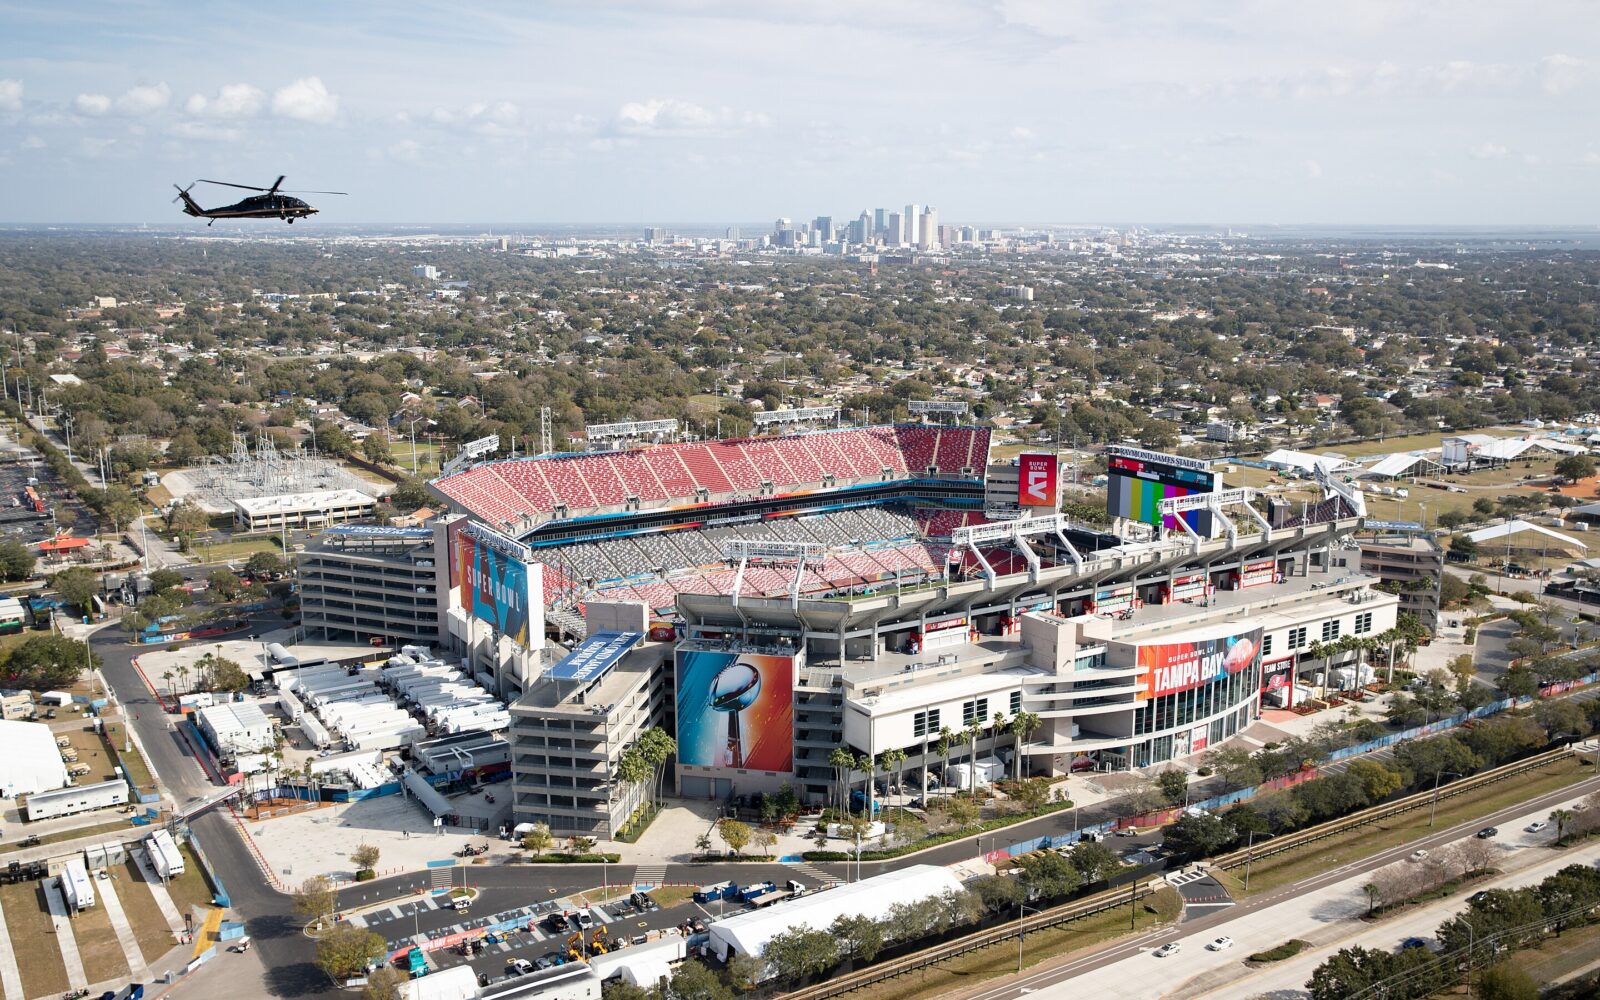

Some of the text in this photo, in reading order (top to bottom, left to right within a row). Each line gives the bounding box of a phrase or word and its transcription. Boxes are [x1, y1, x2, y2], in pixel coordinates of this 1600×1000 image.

[1120, 448, 1205, 469] RAYMOND JAMES STADIUM
[1028, 471, 1047, 501] LV
[467, 565, 520, 612] SUPER BOWL
[1168, 654, 1188, 663] SUPER
[1190, 650, 1206, 658] BOWL
[1264, 659, 1291, 674] TEAM STORE
[1154, 659, 1200, 692] TAMPA
[1201, 652, 1224, 680] BAY
[447, 770, 463, 784] LV
